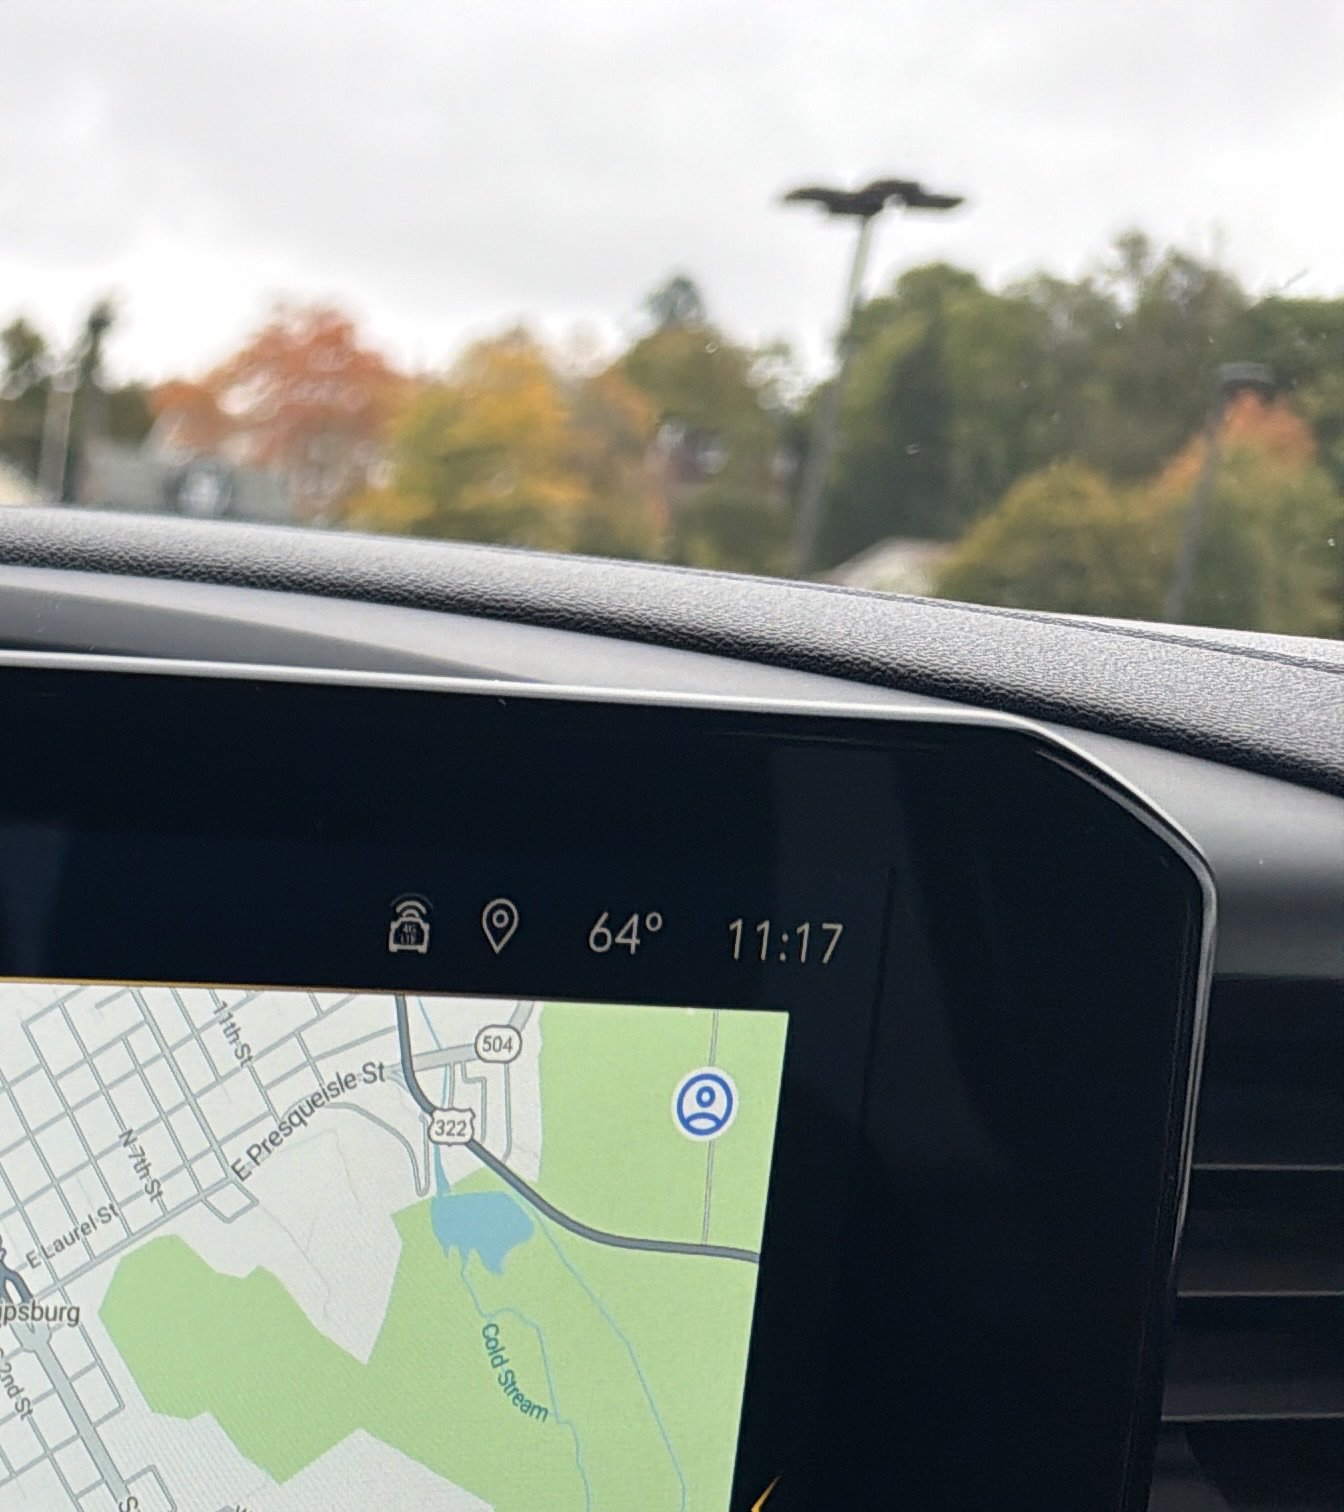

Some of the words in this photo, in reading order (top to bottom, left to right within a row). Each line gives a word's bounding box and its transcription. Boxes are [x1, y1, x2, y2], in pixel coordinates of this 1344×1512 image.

[728, 919, 845, 964] 11:17
[213, 1001, 242, 1045] 11th
[234, 1043, 253, 1068] St
[482, 1034, 513, 1053] 504
[231, 1159, 252, 1182] E
[246, 1072, 358, 1166] Presqueisle
[362, 1061, 386, 1084] St
[434, 1119, 467, 1137] 322
[119, 1129, 137, 1148] N
[129, 1147, 154, 1184] 7th
[144, 1177, 164, 1202] St
[26, 1251, 41, 1268] E
[41, 1218, 97, 1259] Laurel
[96, 1203, 120, 1225] St
[482, 1323, 509, 1368] Cold
[498, 1369, 548, 1422] Stream
[15, 1396, 34, 1420] St
